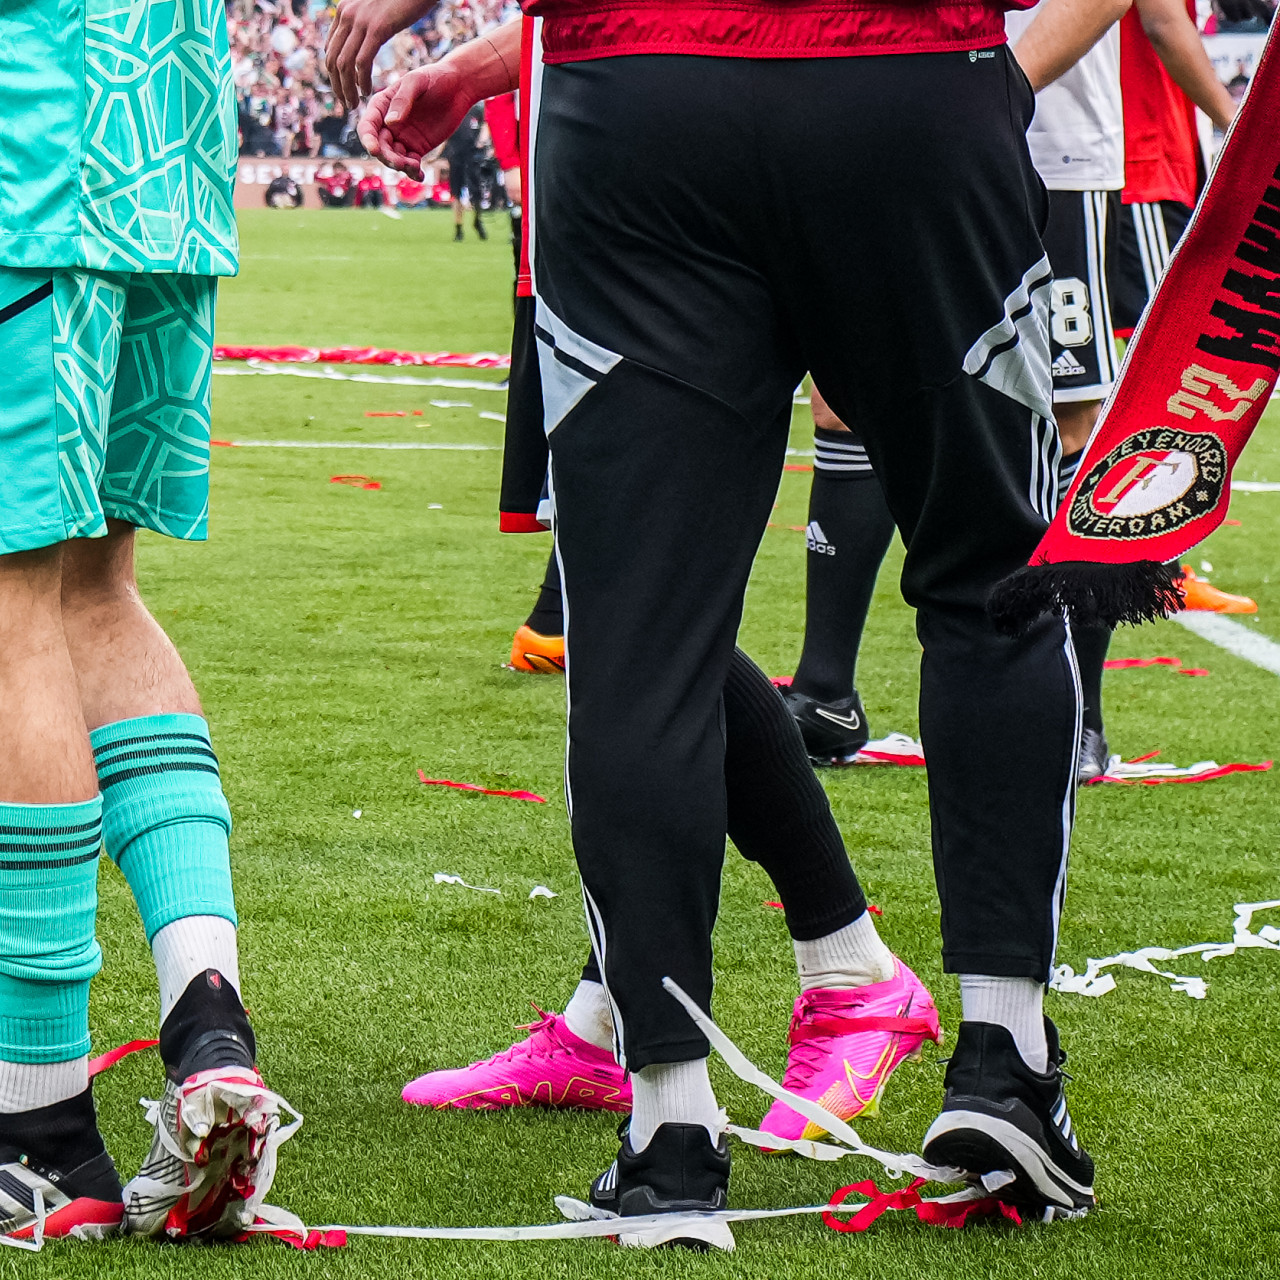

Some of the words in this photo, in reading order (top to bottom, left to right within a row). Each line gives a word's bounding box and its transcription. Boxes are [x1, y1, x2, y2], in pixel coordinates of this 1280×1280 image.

[1051, 276, 1094, 348] 8
[1167, 363, 1269, 422] 22
[1107, 431, 1223, 483] FEYENOORD
[1073, 491, 1192, 534] ROTTERDAM
